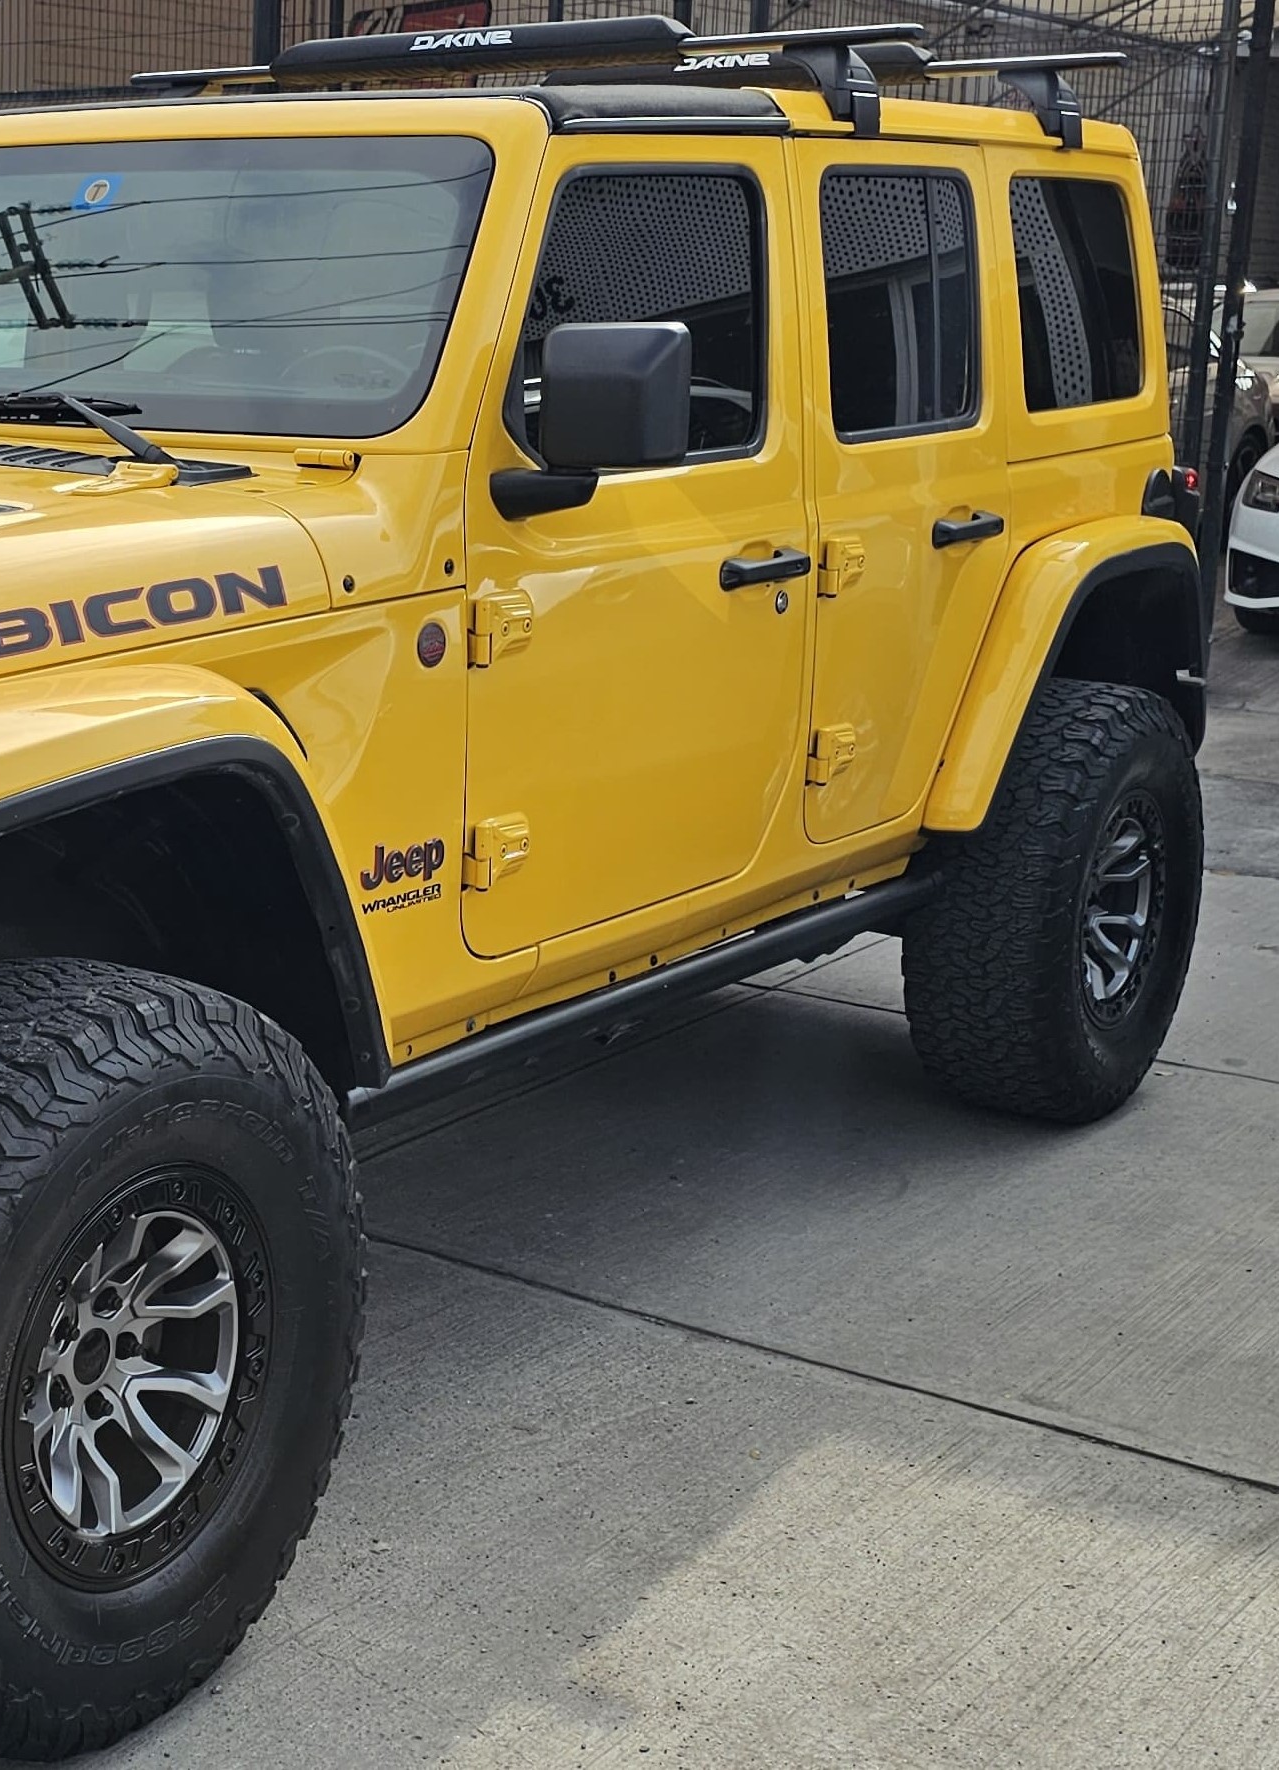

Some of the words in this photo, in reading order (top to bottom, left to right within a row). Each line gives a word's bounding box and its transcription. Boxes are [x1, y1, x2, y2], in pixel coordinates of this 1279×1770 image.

[410, 30, 513, 52] DAKINE
[360, 838, 445, 890] Jeep
[361, 883, 442, 915] WRANGLER
[386, 893, 442, 913] UNLIMITED
